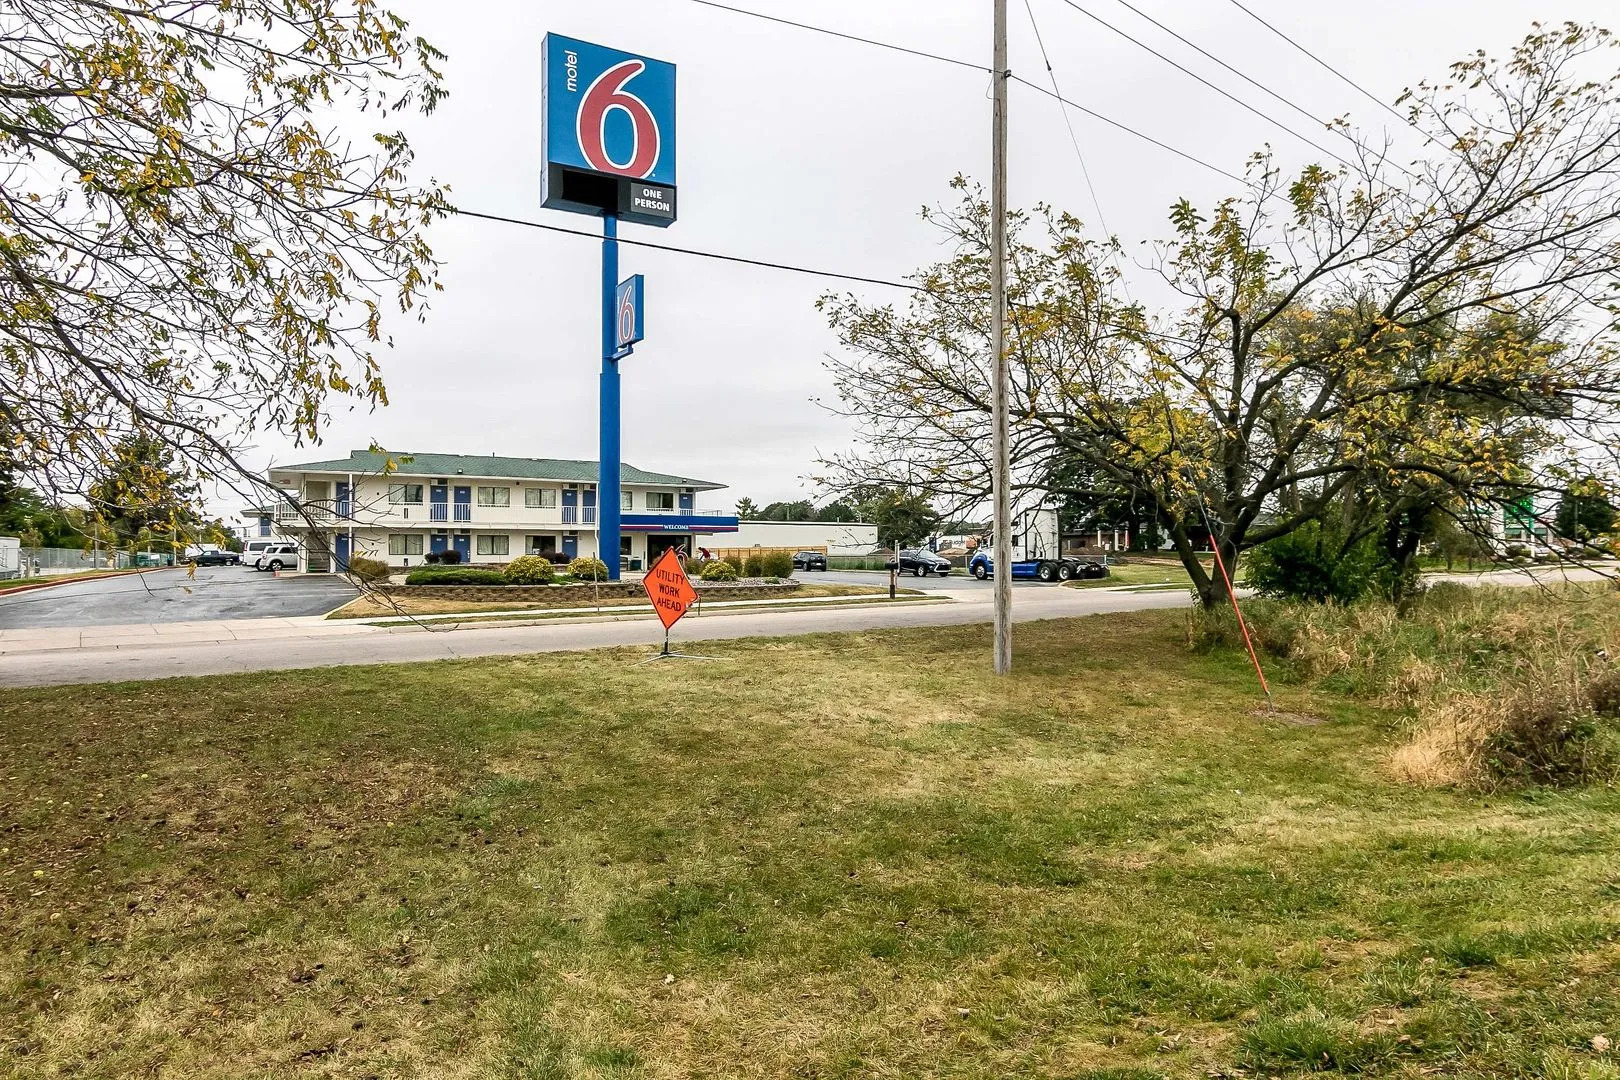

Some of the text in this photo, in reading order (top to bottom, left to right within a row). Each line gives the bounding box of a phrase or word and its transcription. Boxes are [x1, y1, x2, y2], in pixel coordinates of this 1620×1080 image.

[564, 50, 661, 179] motel 6
[643, 188, 663, 200] ONE
[634, 197, 670, 212] PERSON
[618, 285, 635, 344] 6
[656, 569, 686, 585] UTILITY
[659, 583, 680, 599] WORK
[656, 597, 682, 612] AHEAD
